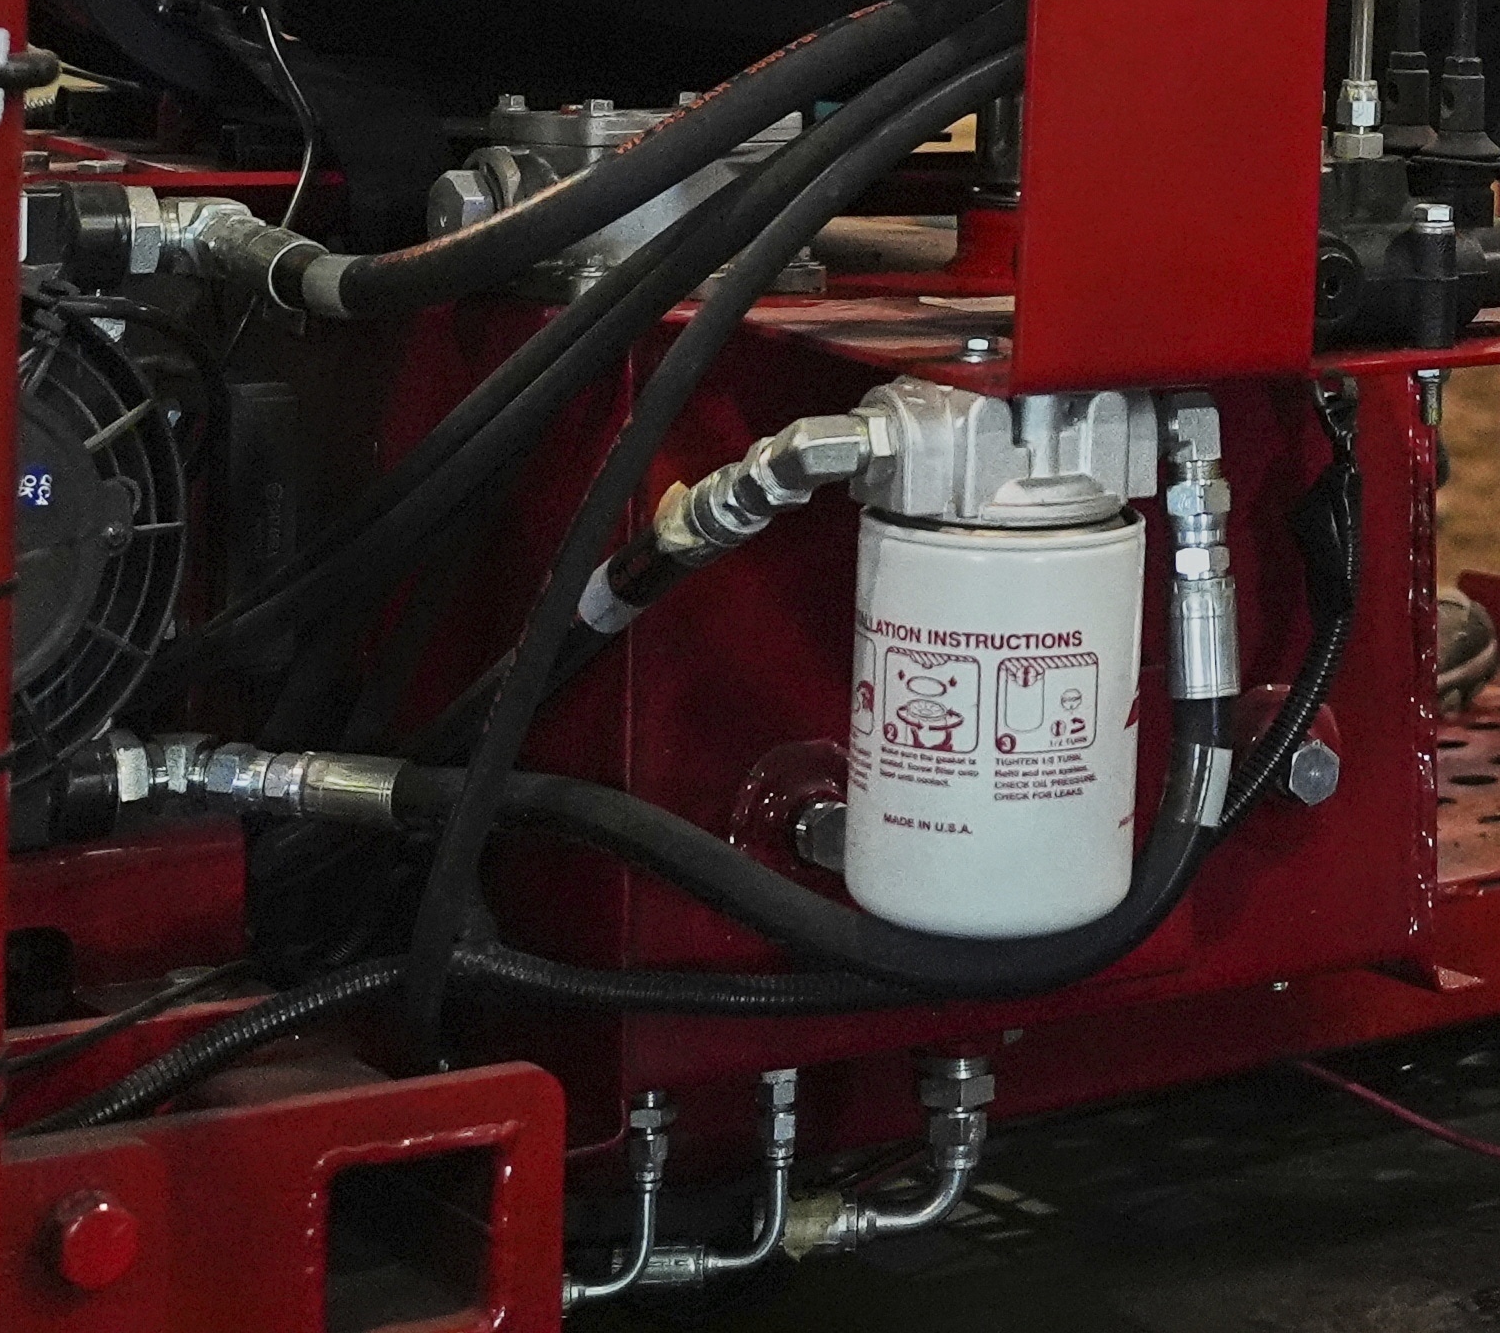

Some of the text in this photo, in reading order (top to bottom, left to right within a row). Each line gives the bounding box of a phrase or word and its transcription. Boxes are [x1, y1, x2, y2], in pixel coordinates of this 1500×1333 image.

[927, 630, 1083, 651] INSTRUCTIONS
[995, 757, 1039, 765] TIGHTEN
[883, 813, 915, 829] MADE
[918, 819, 932, 831] IN
